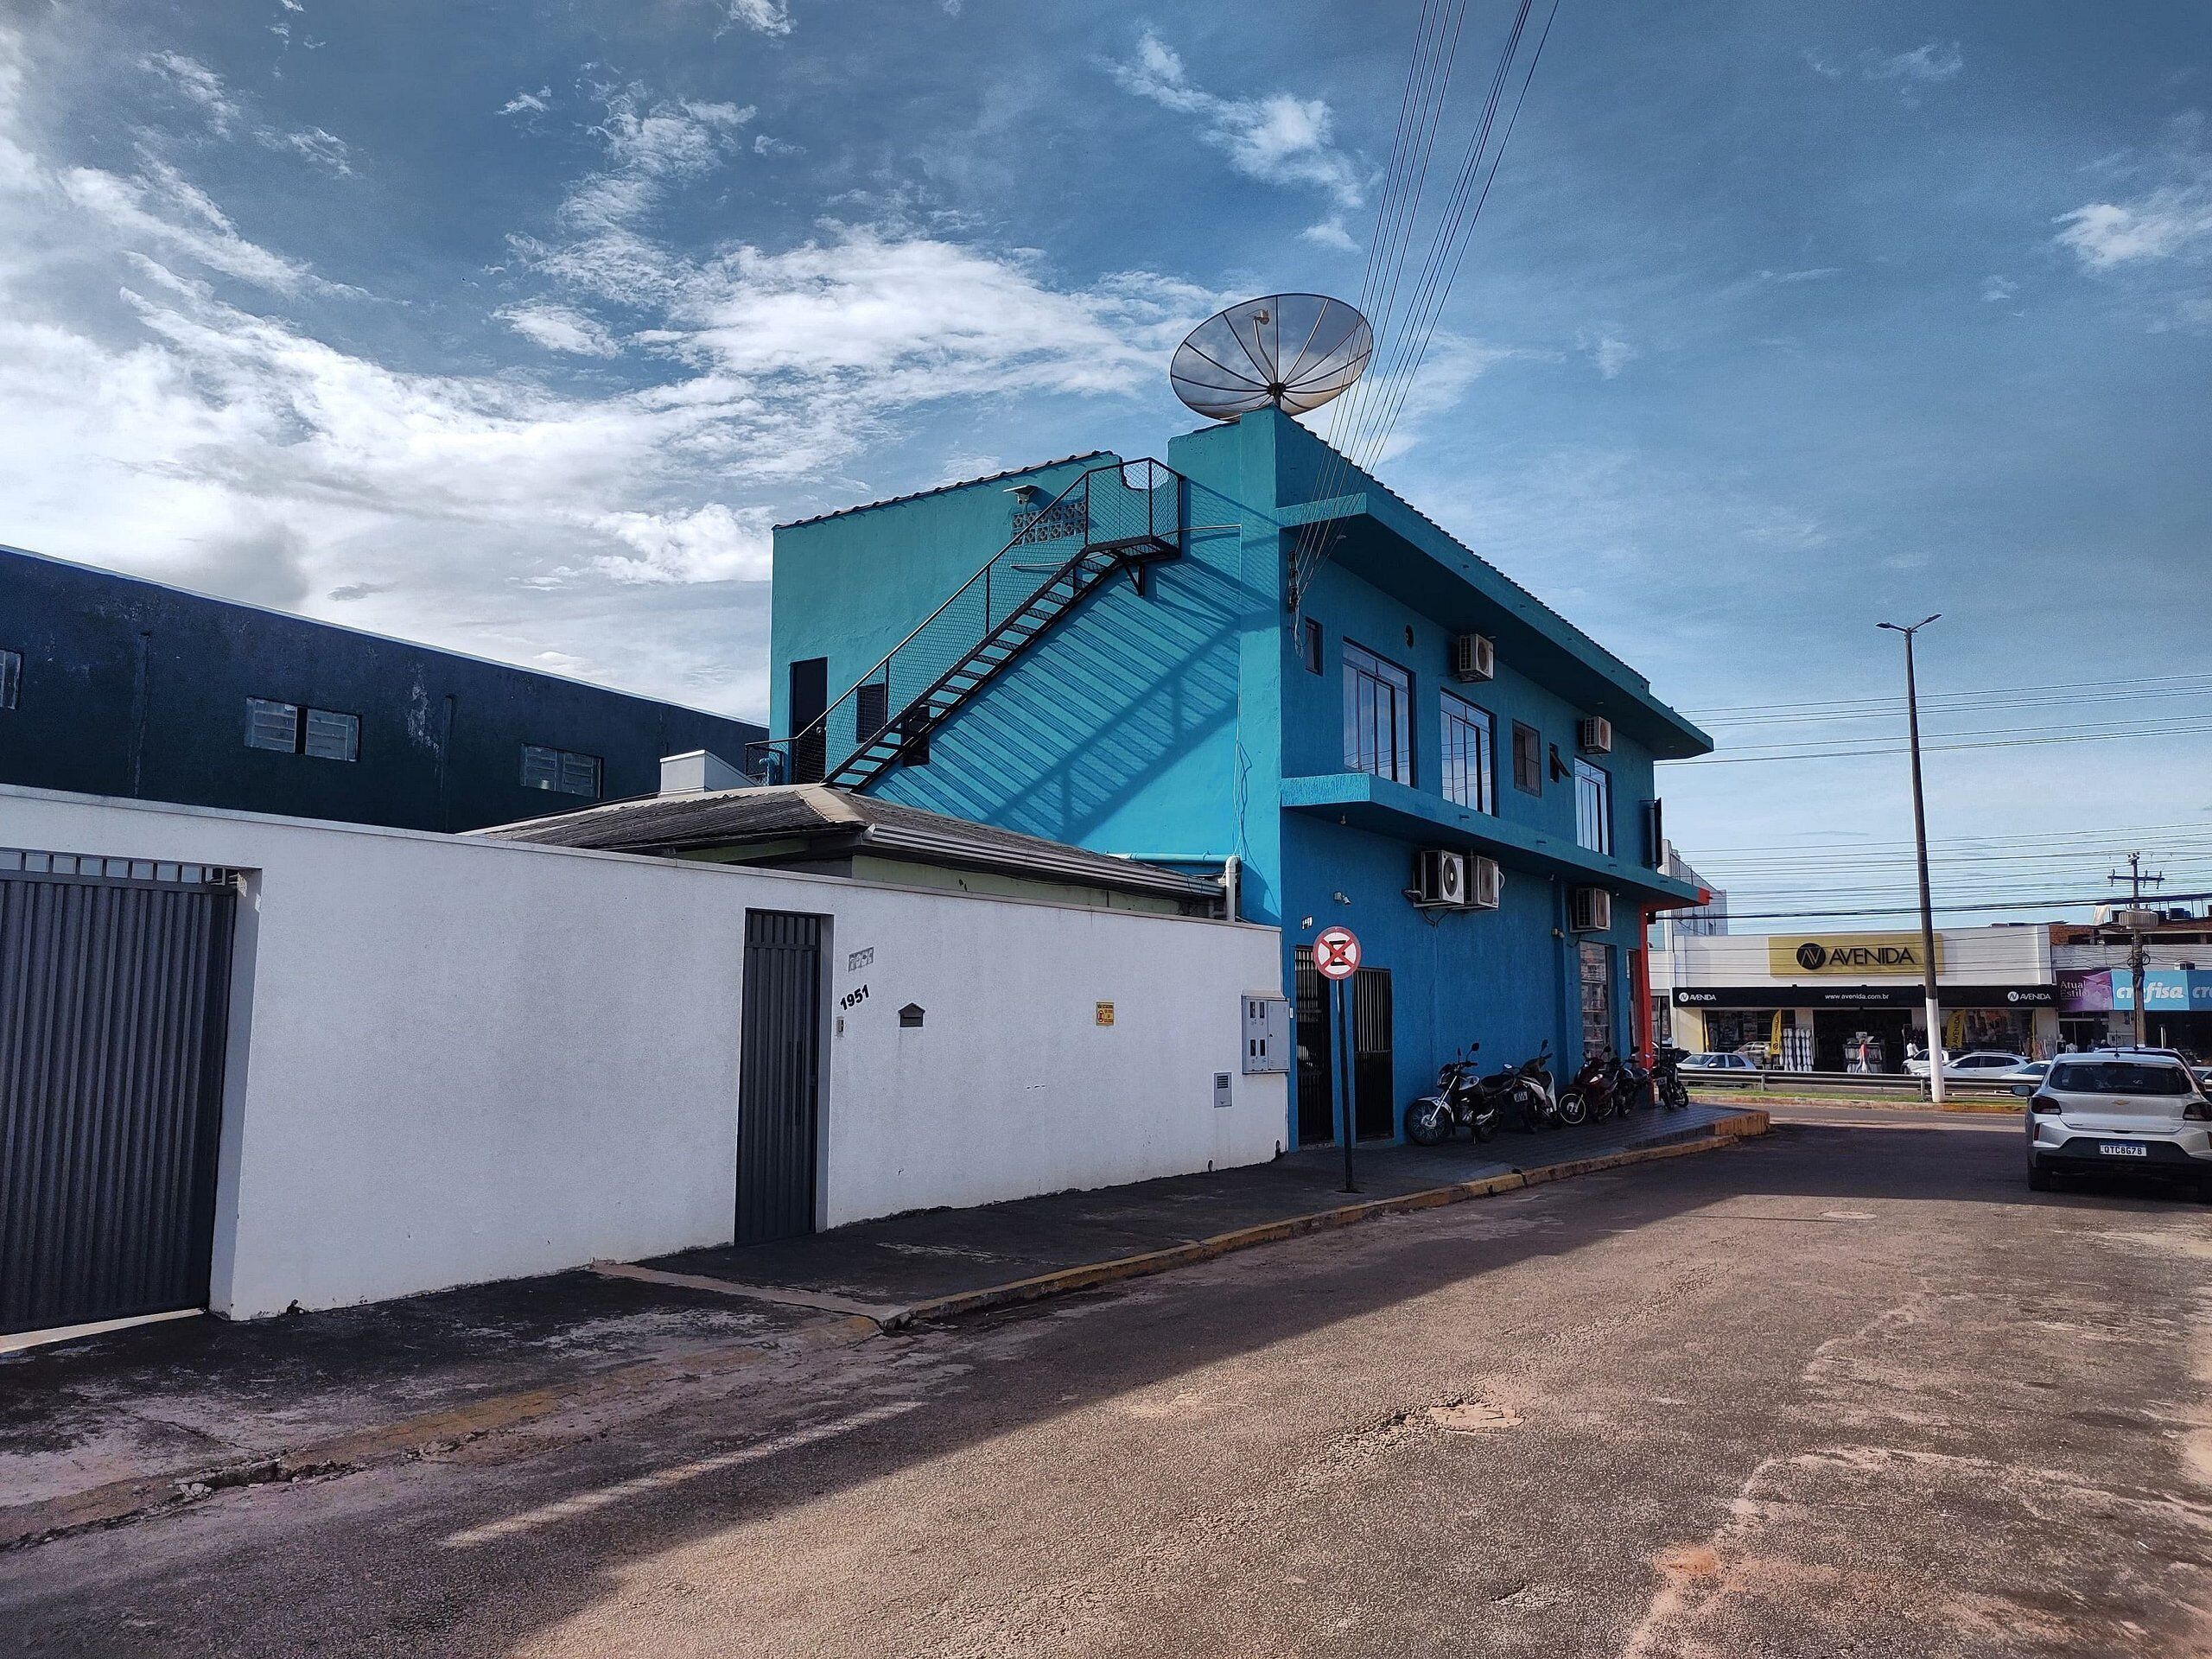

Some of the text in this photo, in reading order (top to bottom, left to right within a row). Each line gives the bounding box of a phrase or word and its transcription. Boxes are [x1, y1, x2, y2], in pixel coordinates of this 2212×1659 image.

[1828, 947, 1916, 966] AVENIDA
[2060, 980, 2086, 989] Atual
[2060, 988, 2088, 998] Estilo
[2116, 982, 2184, 1003] crfisa
[840, 983, 869, 1011] 1951
